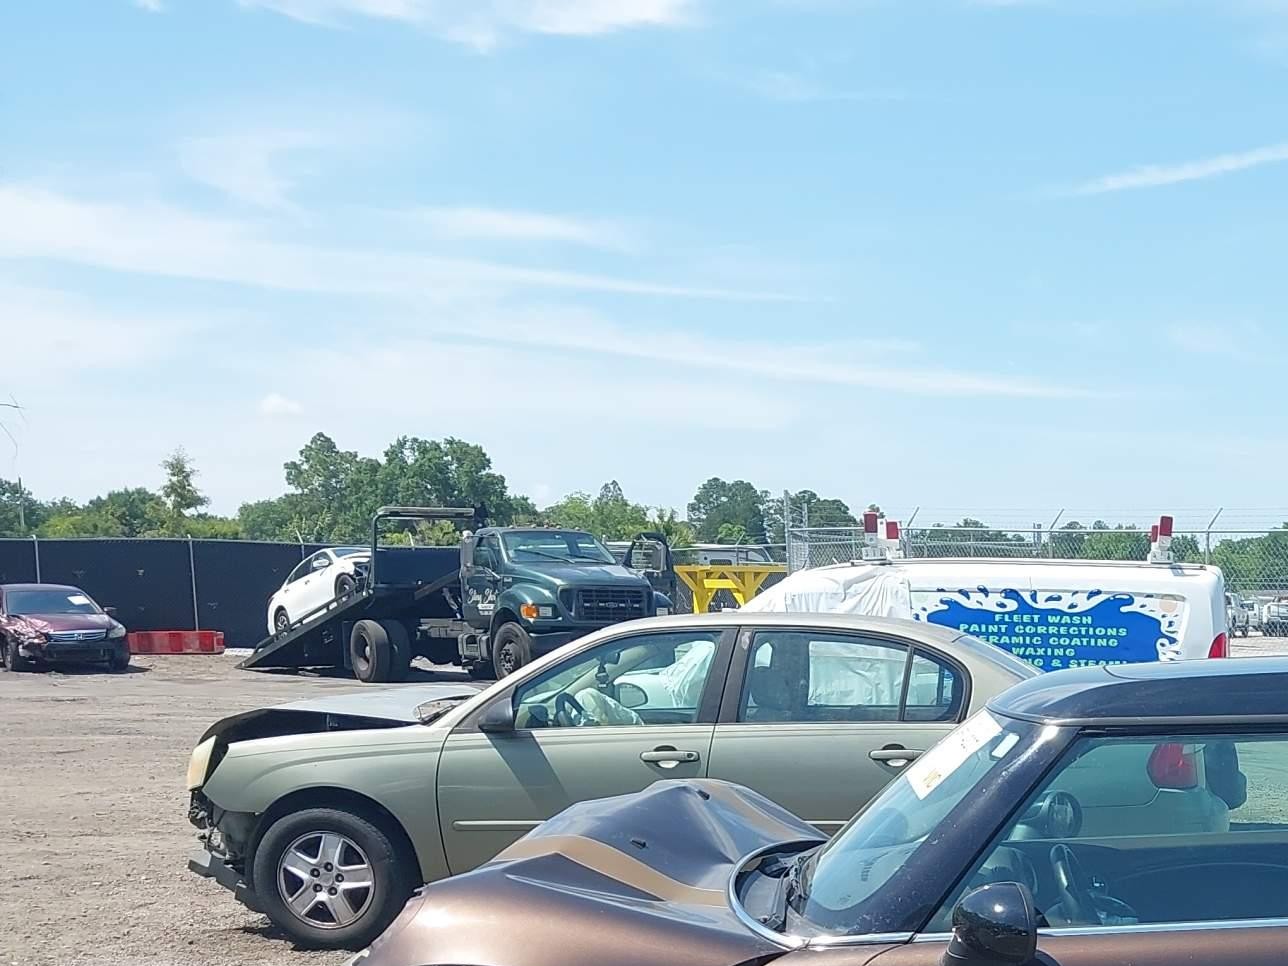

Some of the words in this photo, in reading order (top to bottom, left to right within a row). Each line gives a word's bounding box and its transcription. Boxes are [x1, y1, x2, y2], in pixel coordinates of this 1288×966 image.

[994, 613, 1041, 623] FLEET
[1047, 615, 1092, 625] WASH
[959, 623, 1009, 633] PAINT
[1014, 625, 1128, 637] CORRECTIONS
[979, 635, 1042, 645] ERAMIC
[1048, 636, 1119, 648] COATING
[1011, 647, 1076, 657] WAXING
[1050, 658, 1063, 668] &
